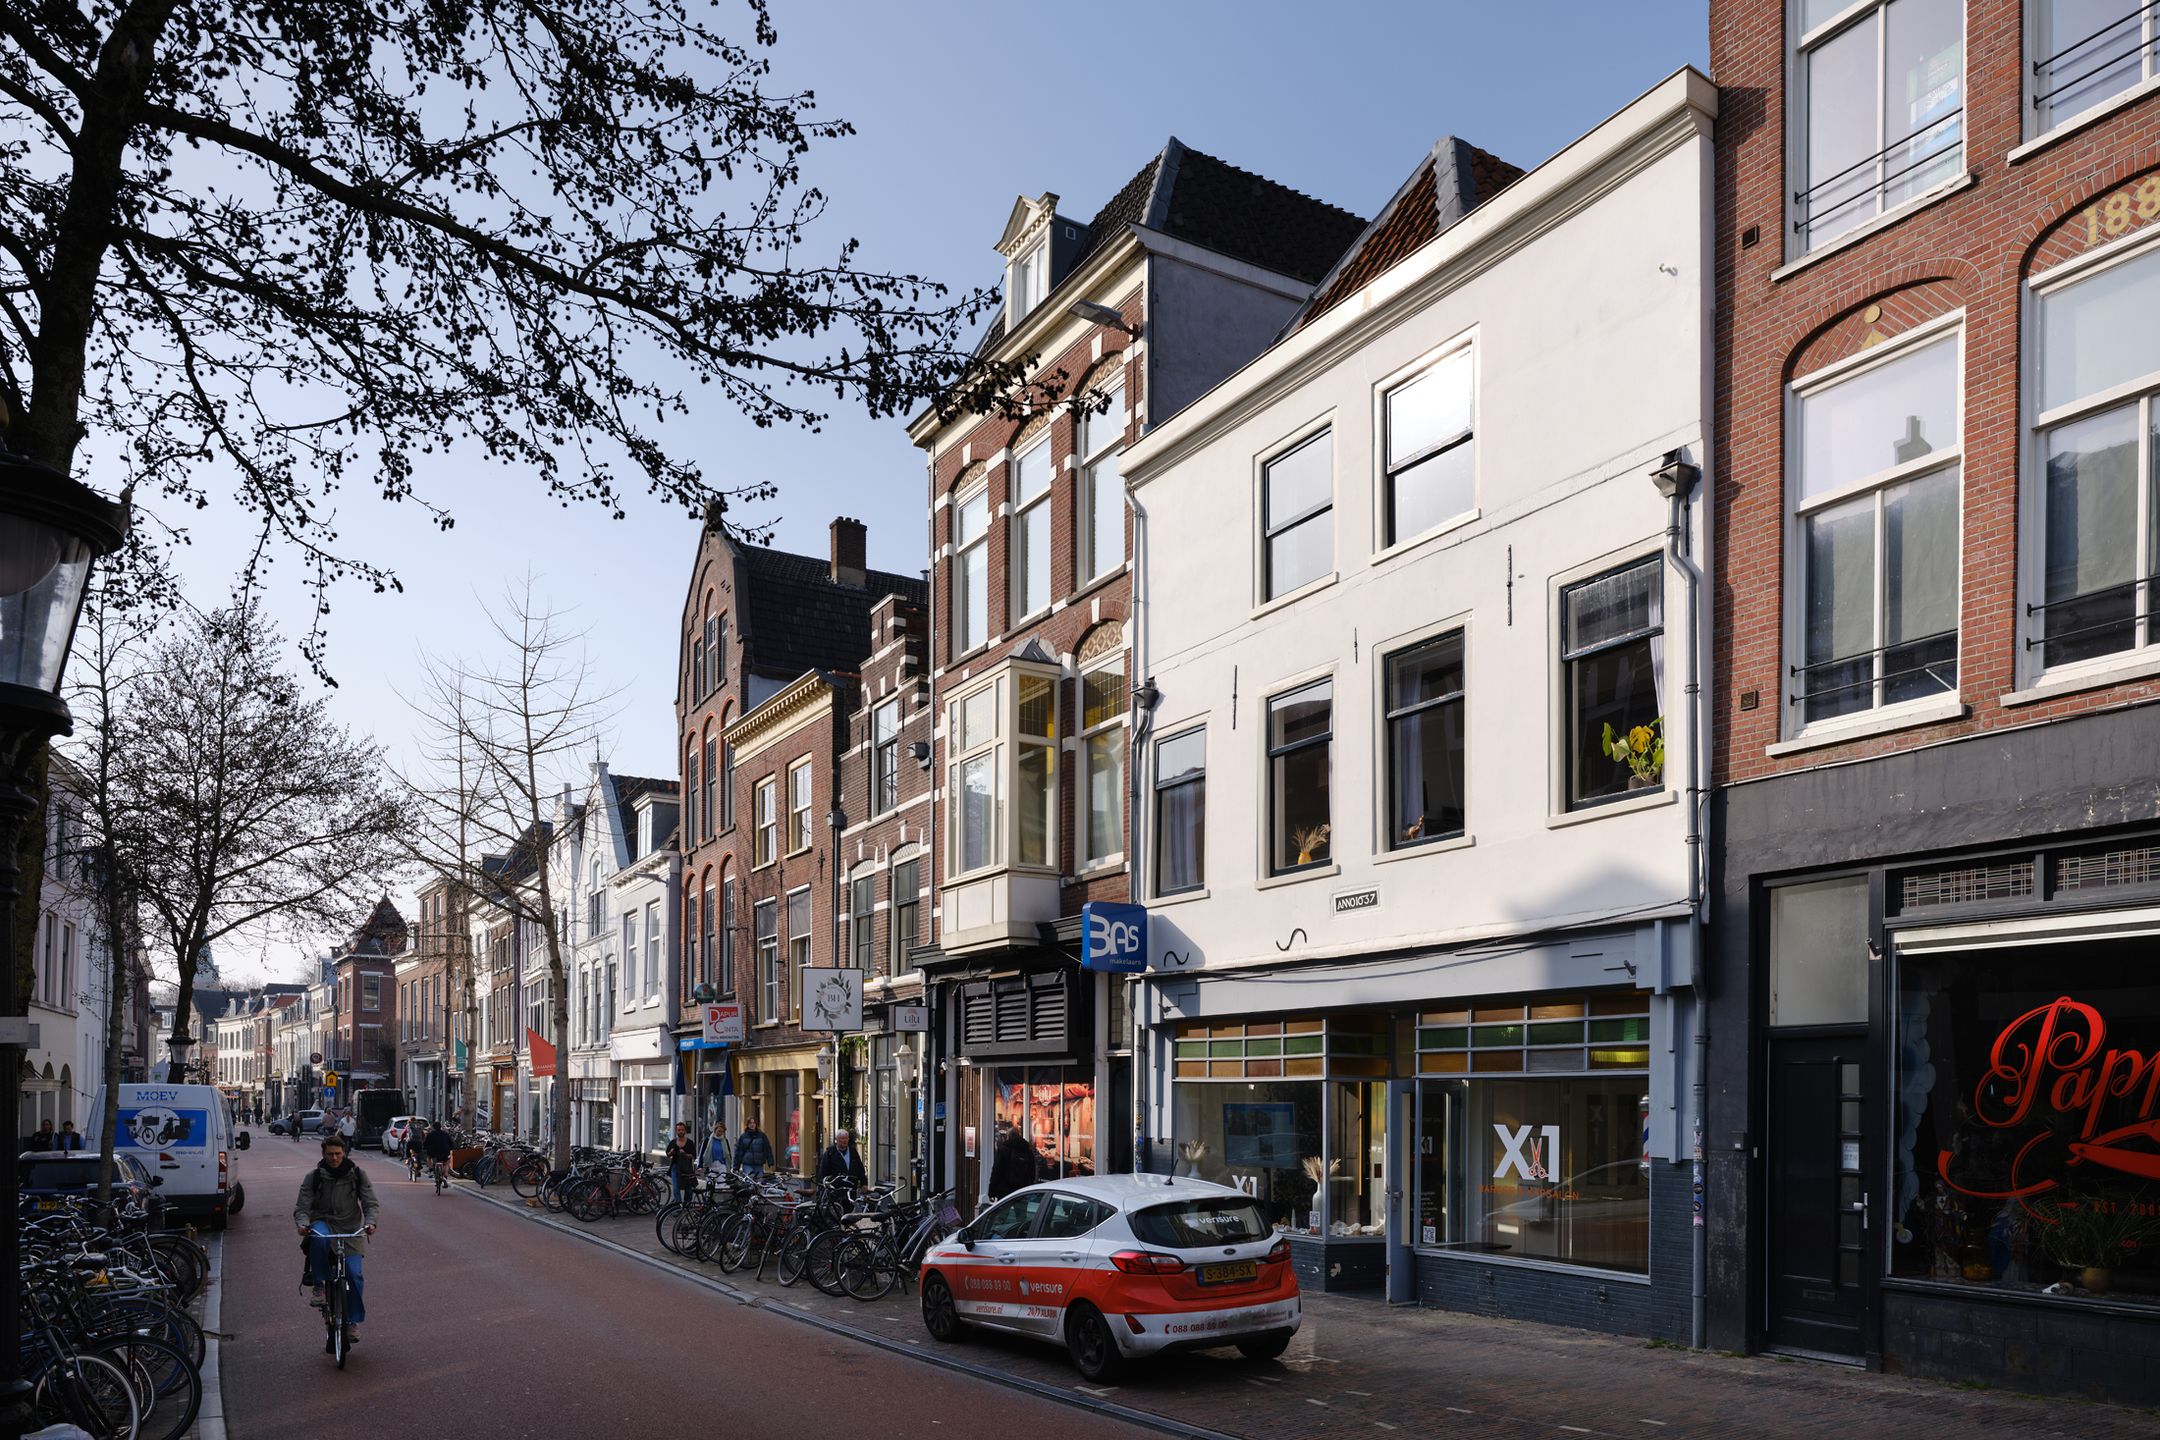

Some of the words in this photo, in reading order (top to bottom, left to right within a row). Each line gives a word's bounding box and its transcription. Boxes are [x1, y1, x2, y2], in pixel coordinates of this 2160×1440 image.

[1090, 914, 1139, 958] BAS
[136, 1091, 178, 1101] MOEV
[1493, 1124, 1560, 1183] X1
[1199, 1214, 1240, 1225] verisure
[1206, 1261, 1251, 1280] S-384-SX
[1030, 1282, 1063, 1294] verisure
[1172, 1326, 1188, 1334] 088
[1191, 1325, 1205, 1333] 088
